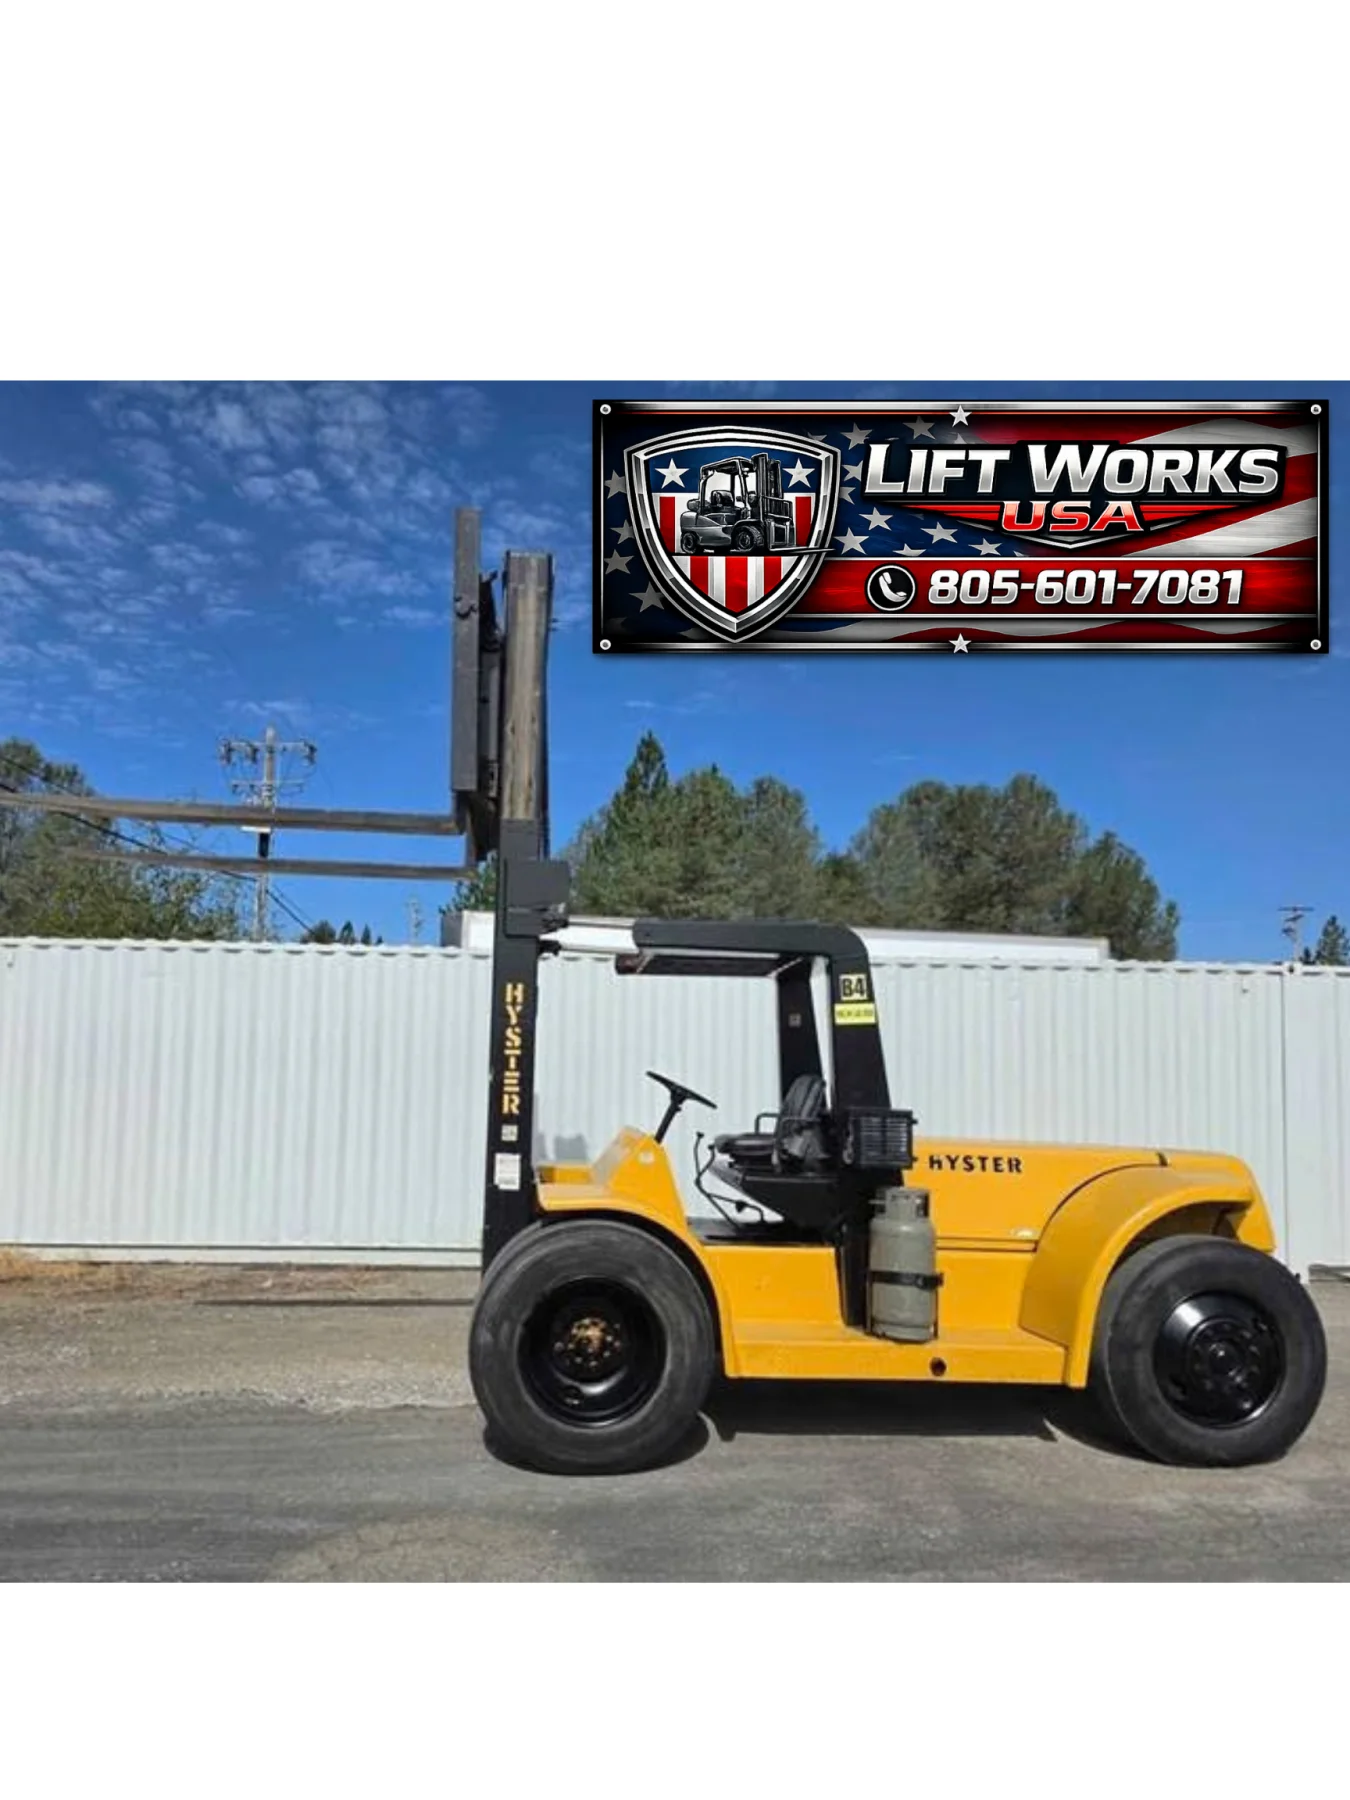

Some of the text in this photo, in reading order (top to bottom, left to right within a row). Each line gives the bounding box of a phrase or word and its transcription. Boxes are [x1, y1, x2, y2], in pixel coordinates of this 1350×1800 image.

[843, 977, 865, 998] B4
[502, 982, 524, 1114] HYSTER
[928, 1154, 1022, 1173] HYSTER
